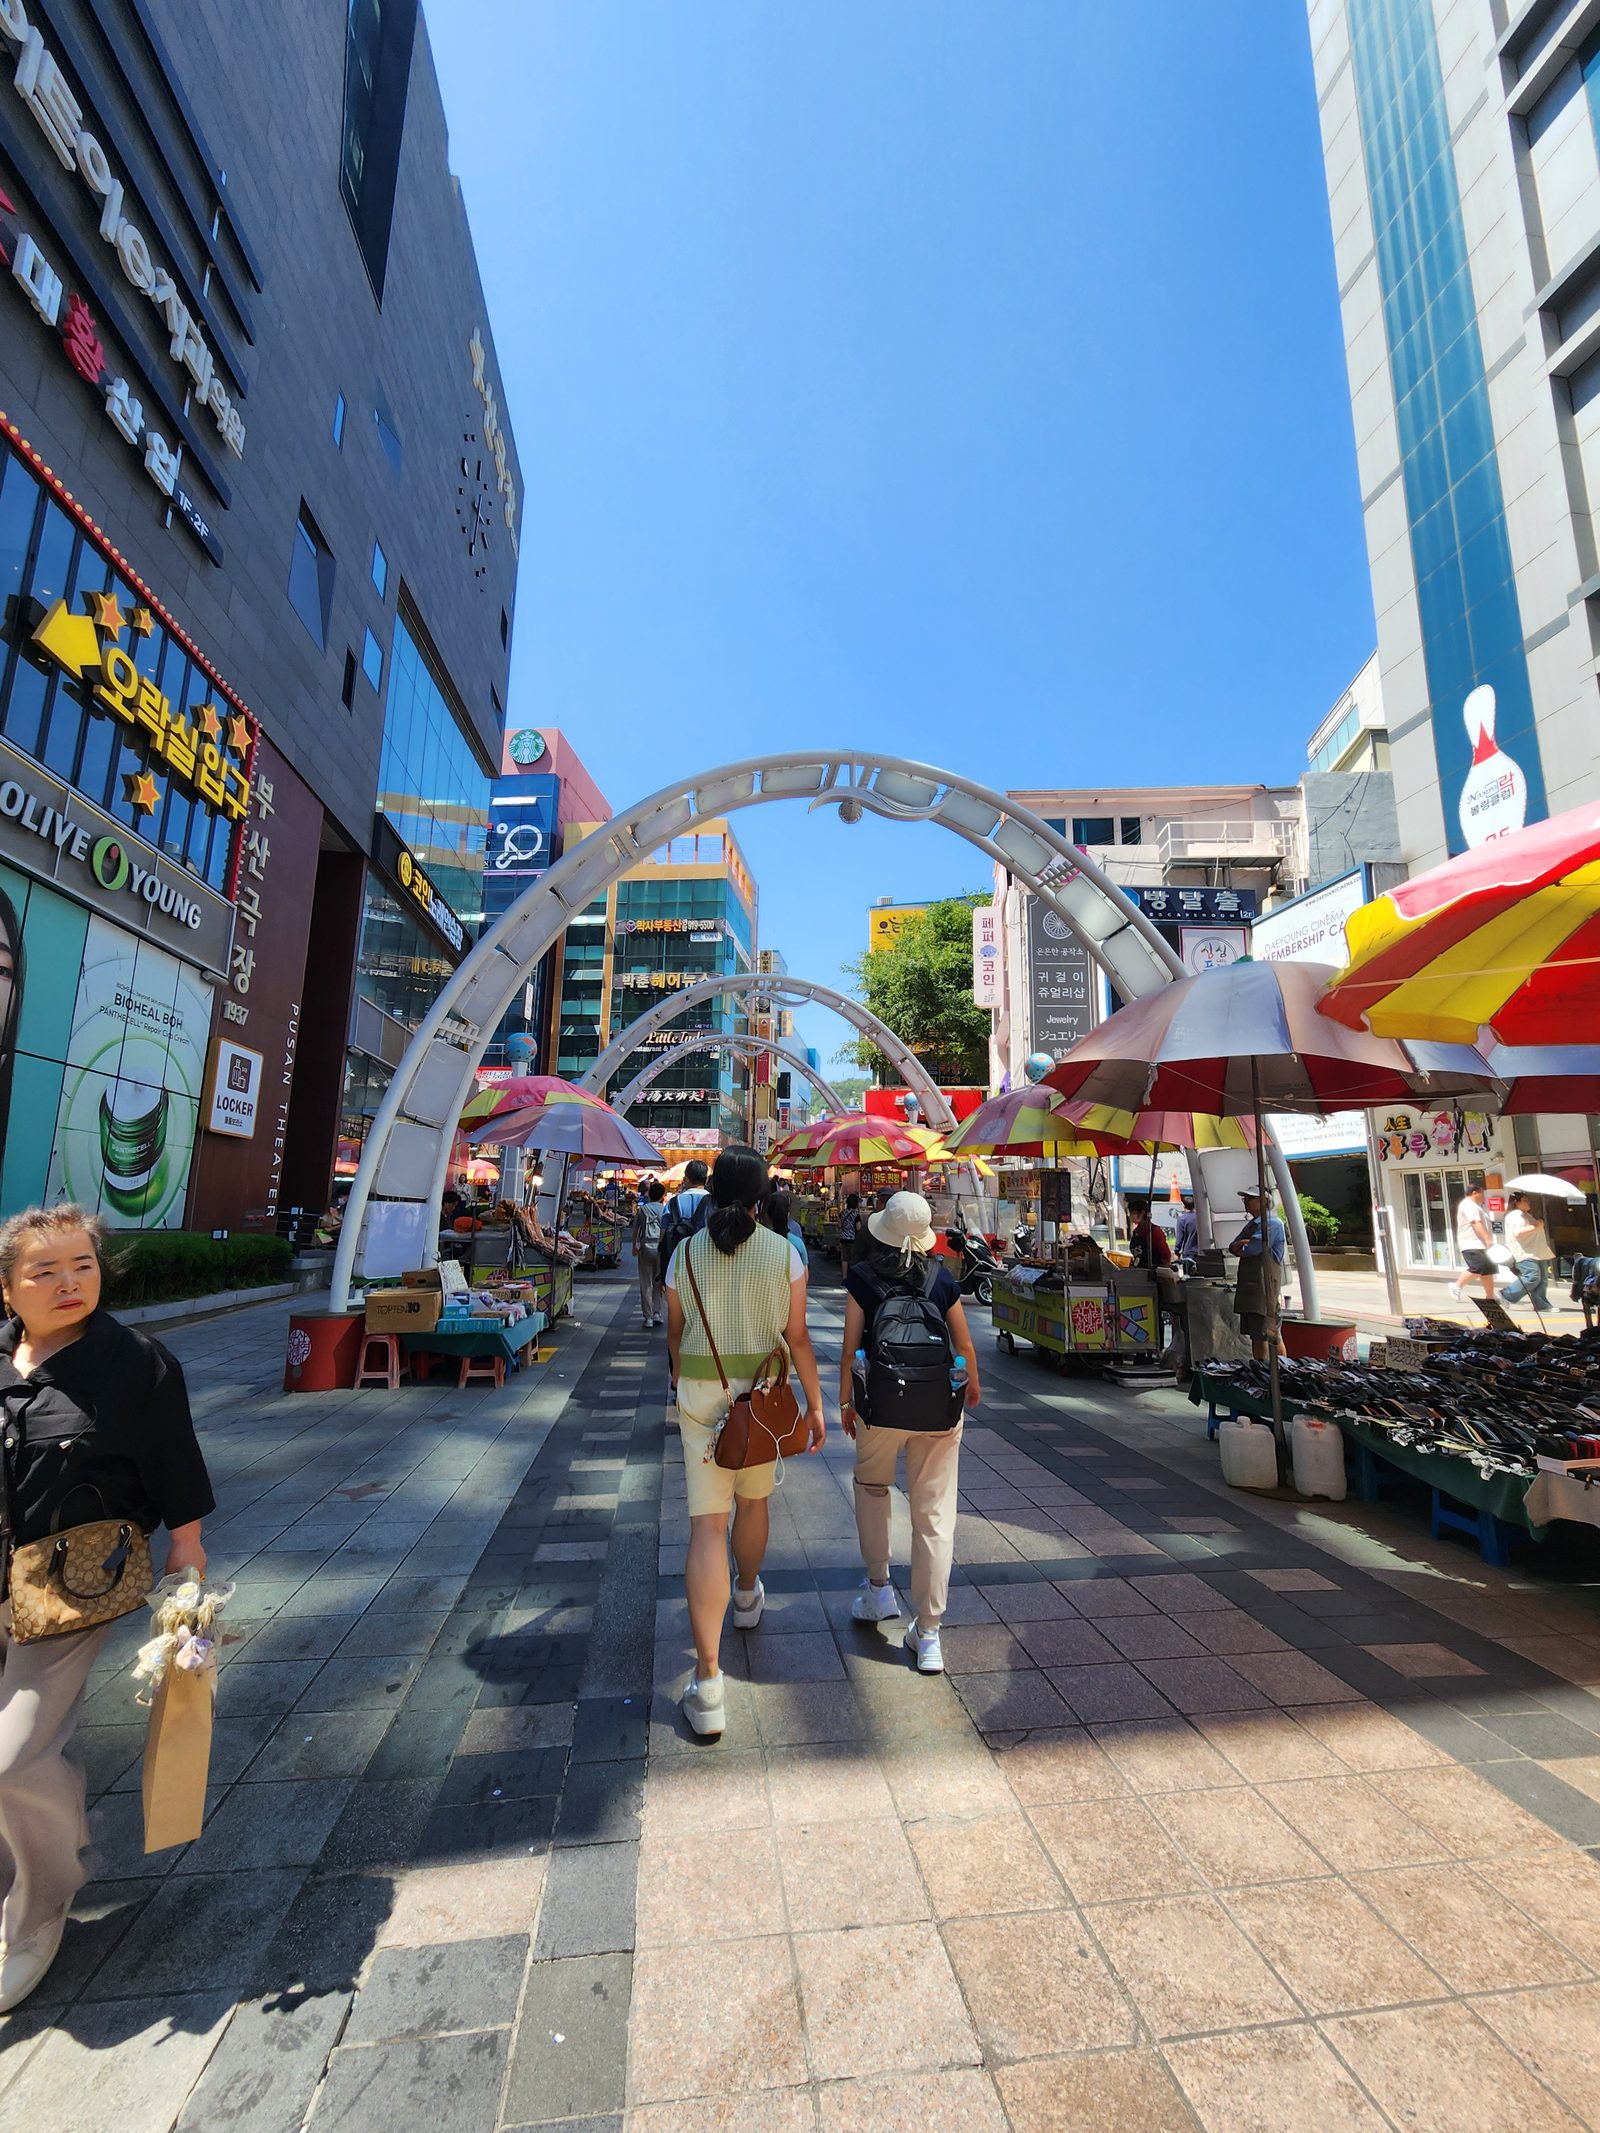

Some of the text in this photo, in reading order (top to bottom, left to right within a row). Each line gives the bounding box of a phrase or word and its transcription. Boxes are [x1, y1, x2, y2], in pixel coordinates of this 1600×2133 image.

[93, 646, 251, 821] 오락실입구
[1470, 789, 1511, 816] 볼링클럽
[1, 780, 201, 931] OLIVE YOUNG
[232, 774, 276, 994] 부산극장
[1143, 890, 1241, 911] 방탈출
[1264, 908, 1347, 953] DAEYOUNG CINEMA
[1262, 929, 1326, 960] MEMBERSHIP
[983, 960, 996, 986] 코인
[1038, 987, 1085, 999] 쥬얼리샵
[114, 993, 160, 1022] BIOHEAL
[162, 1012, 183, 1030] BOH
[223, 1000, 250, 1026] 1937
[1046, 1014, 1079, 1025] Jewelry
[143, 1022, 162, 1036] Repair
[646, 1031, 679, 1044] Little
[1039, 1030, 1085, 1041] ジュエリー
[216, 1095, 254, 1117] LOCKER
[264, 1003, 299, 1217] PUSAN THEATER
[1384, 1114, 1413, 1132] 人生
